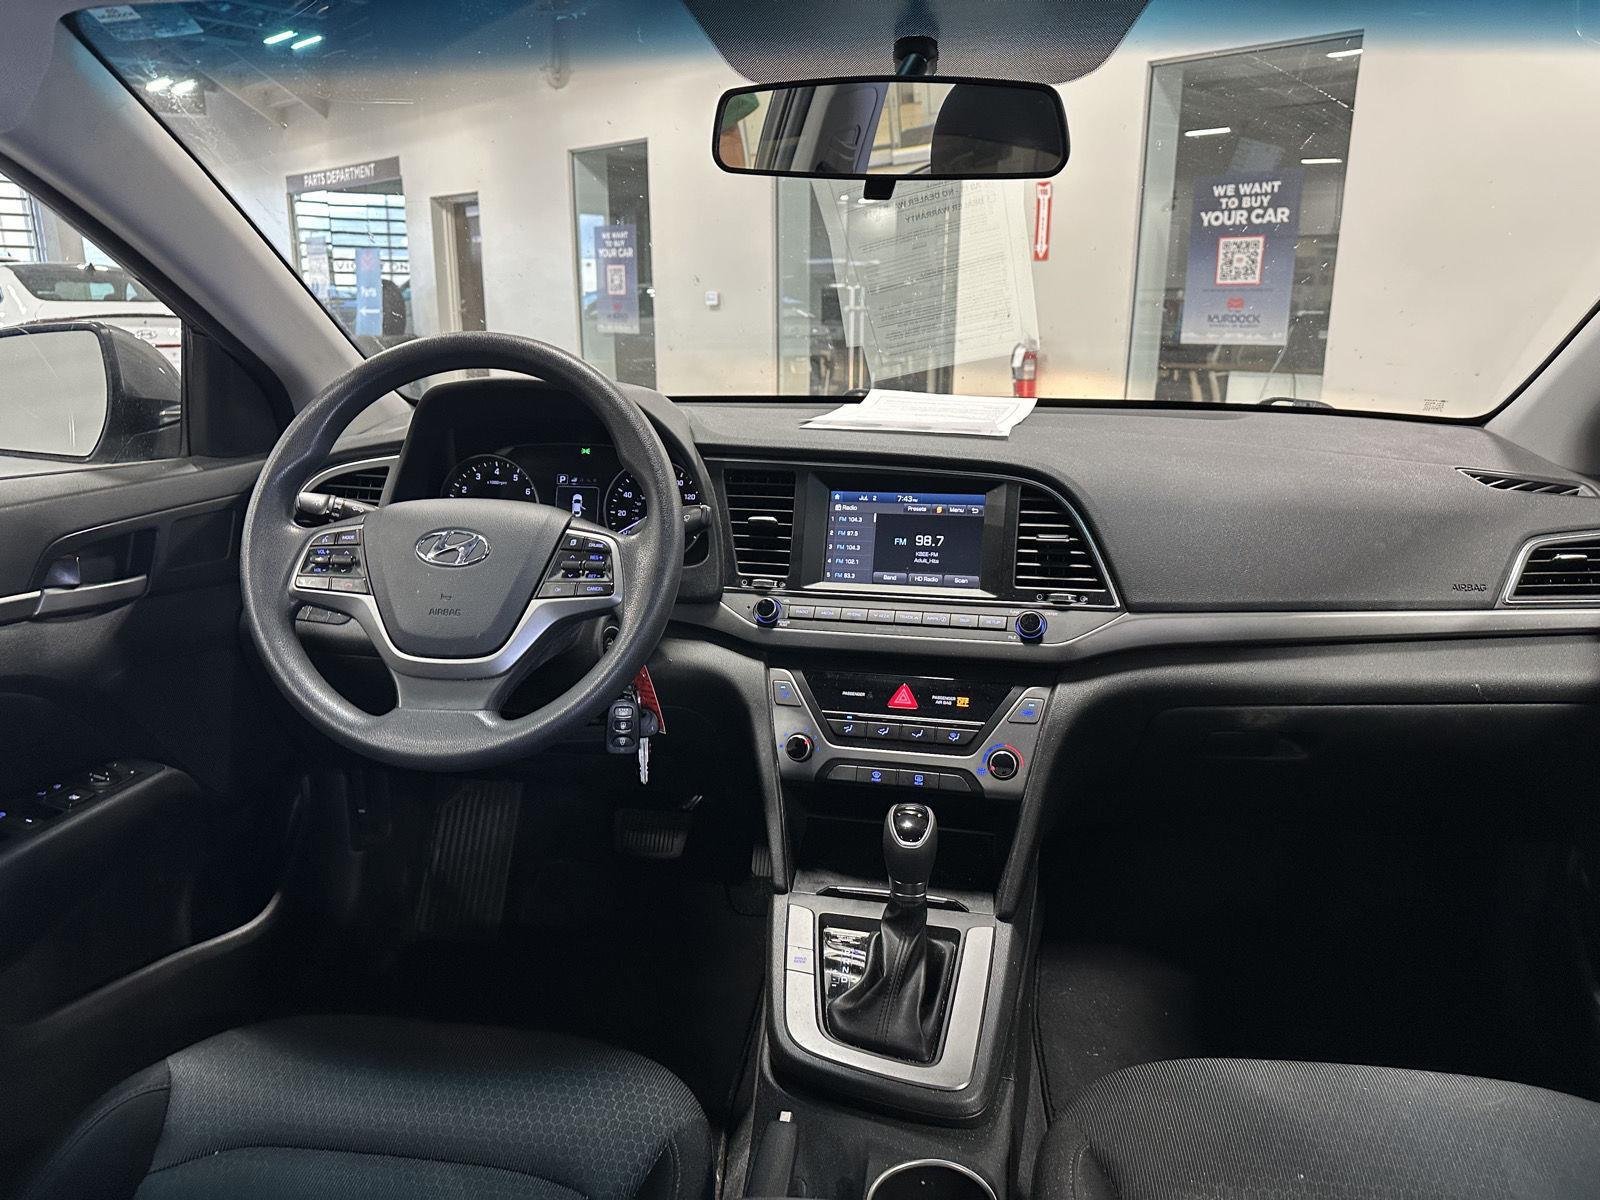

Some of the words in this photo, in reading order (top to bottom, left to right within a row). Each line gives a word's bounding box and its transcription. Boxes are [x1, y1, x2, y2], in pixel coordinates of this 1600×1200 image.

[304, 173, 325, 188] PARTS
[326, 163, 376, 185] DEPARTMENT
[1213, 184, 1236, 197] WE
[1239, 181, 1282, 195] WANT
[1220, 197, 1239, 209] TO
[1242, 195, 1271, 208] BUY
[1200, 210, 1249, 227] YOUR
[1251, 207, 1290, 225] CAR
[599, 248, 617, 257] YOUR
[618, 247, 634, 257] CAR
[685, 493, 696, 501] 120
[894, 537, 907, 546] FM
[915, 535, 945, 547] 98.7
[1452, 583, 1487, 592] AIRBAG
[429, 608, 461, 617] AIRBAG
[957, 697, 969, 706] OFF
